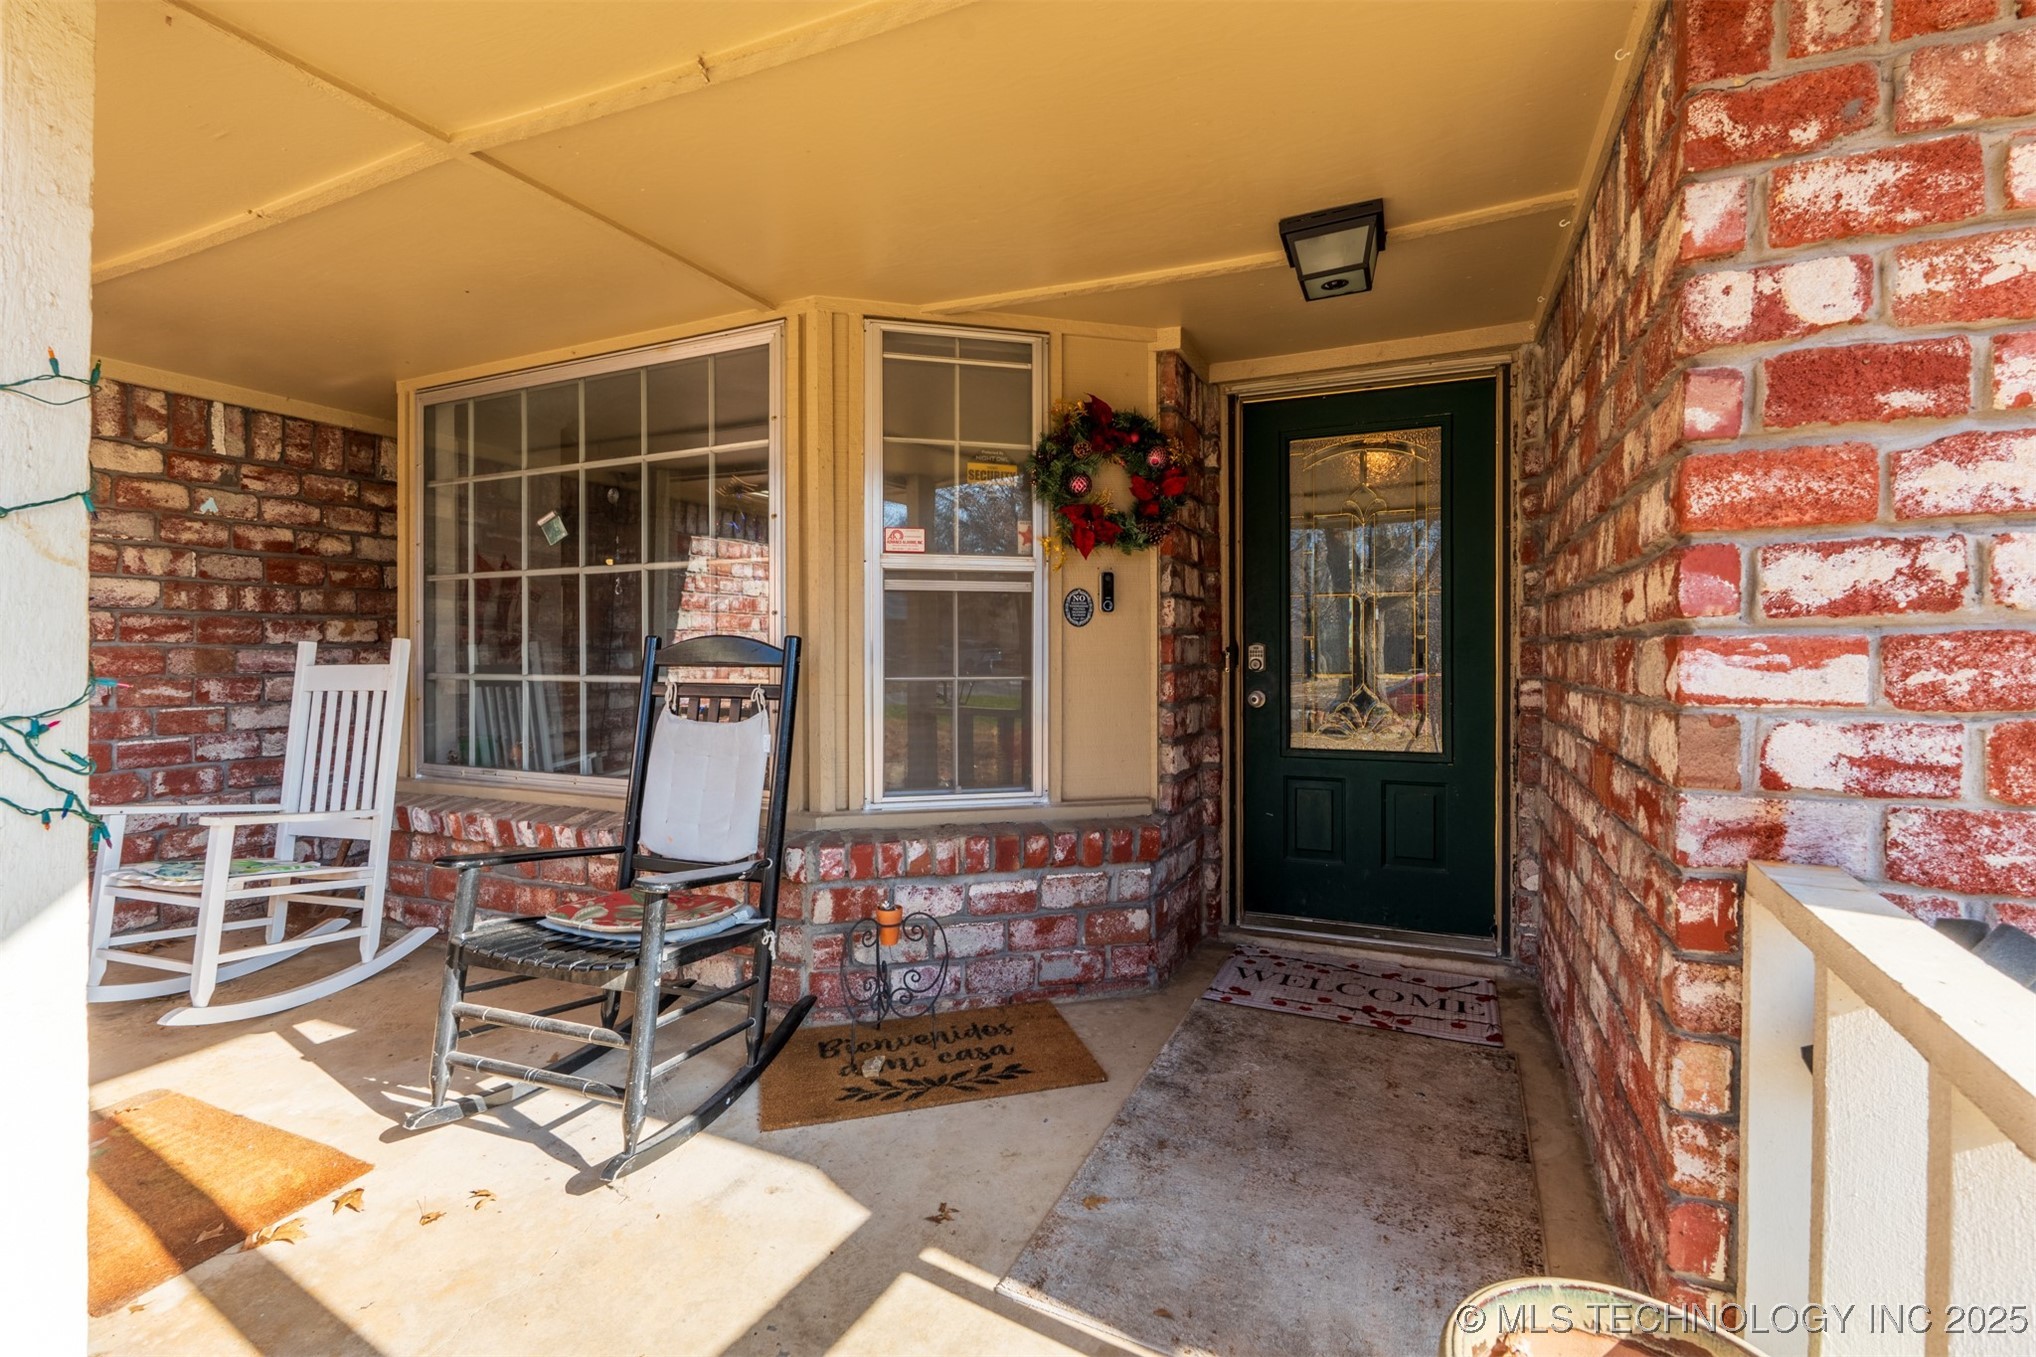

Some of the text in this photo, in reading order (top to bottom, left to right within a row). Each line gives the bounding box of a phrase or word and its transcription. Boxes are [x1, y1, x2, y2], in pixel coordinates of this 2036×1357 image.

[968, 468, 1016, 481] SECURITY
[1236, 966, 1486, 1016] WELCOME
[818, 1021, 1015, 1060] Bienvenidos
[937, 1043, 1015, 1064] casa
